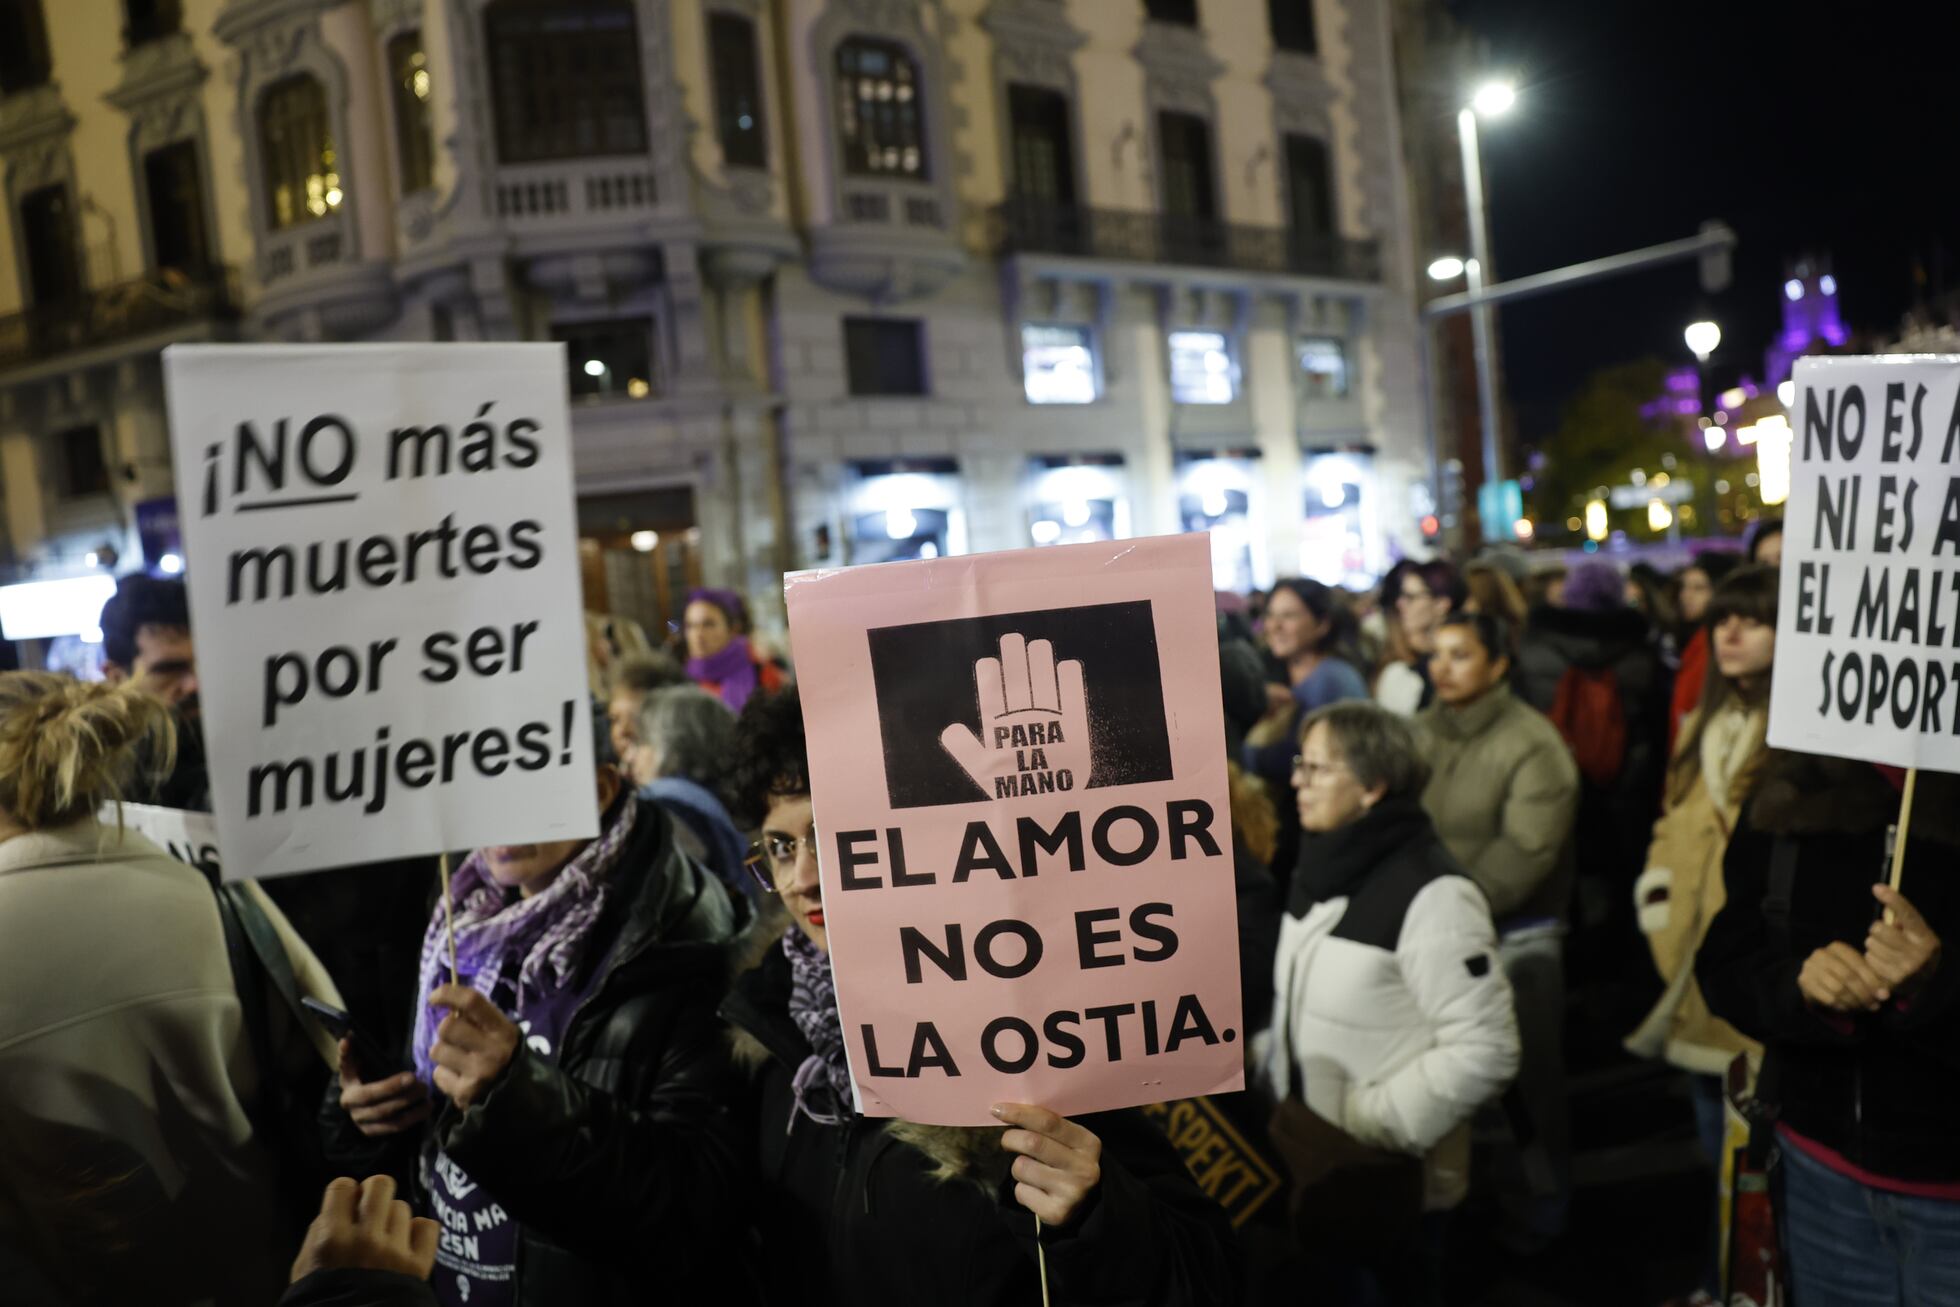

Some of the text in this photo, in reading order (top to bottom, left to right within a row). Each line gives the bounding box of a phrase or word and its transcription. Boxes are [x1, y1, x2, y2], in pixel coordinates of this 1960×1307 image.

[202, 401, 541, 517] ¡NO más
[1803, 384, 1866, 462] NO
[1881, 382, 1928, 462] ES
[1814, 475, 1861, 550] NI
[1873, 476, 1919, 553] ES
[226, 513, 542, 606] muertes
[1796, 561, 1834, 635] EL
[263, 620, 539, 728] por ser
[246, 699, 575, 819] mujeres!
[993, 721, 1065, 749] PARA
[1016, 748, 1048, 772] LA
[994, 769, 1073, 799] MANO
[836, 799, 1223, 891] EL AMOR
[899, 902, 1179, 984] NO ES
[860, 994, 1237, 1078] LA OSTIA.
[1145, 1101, 1260, 1208] SPEKT
